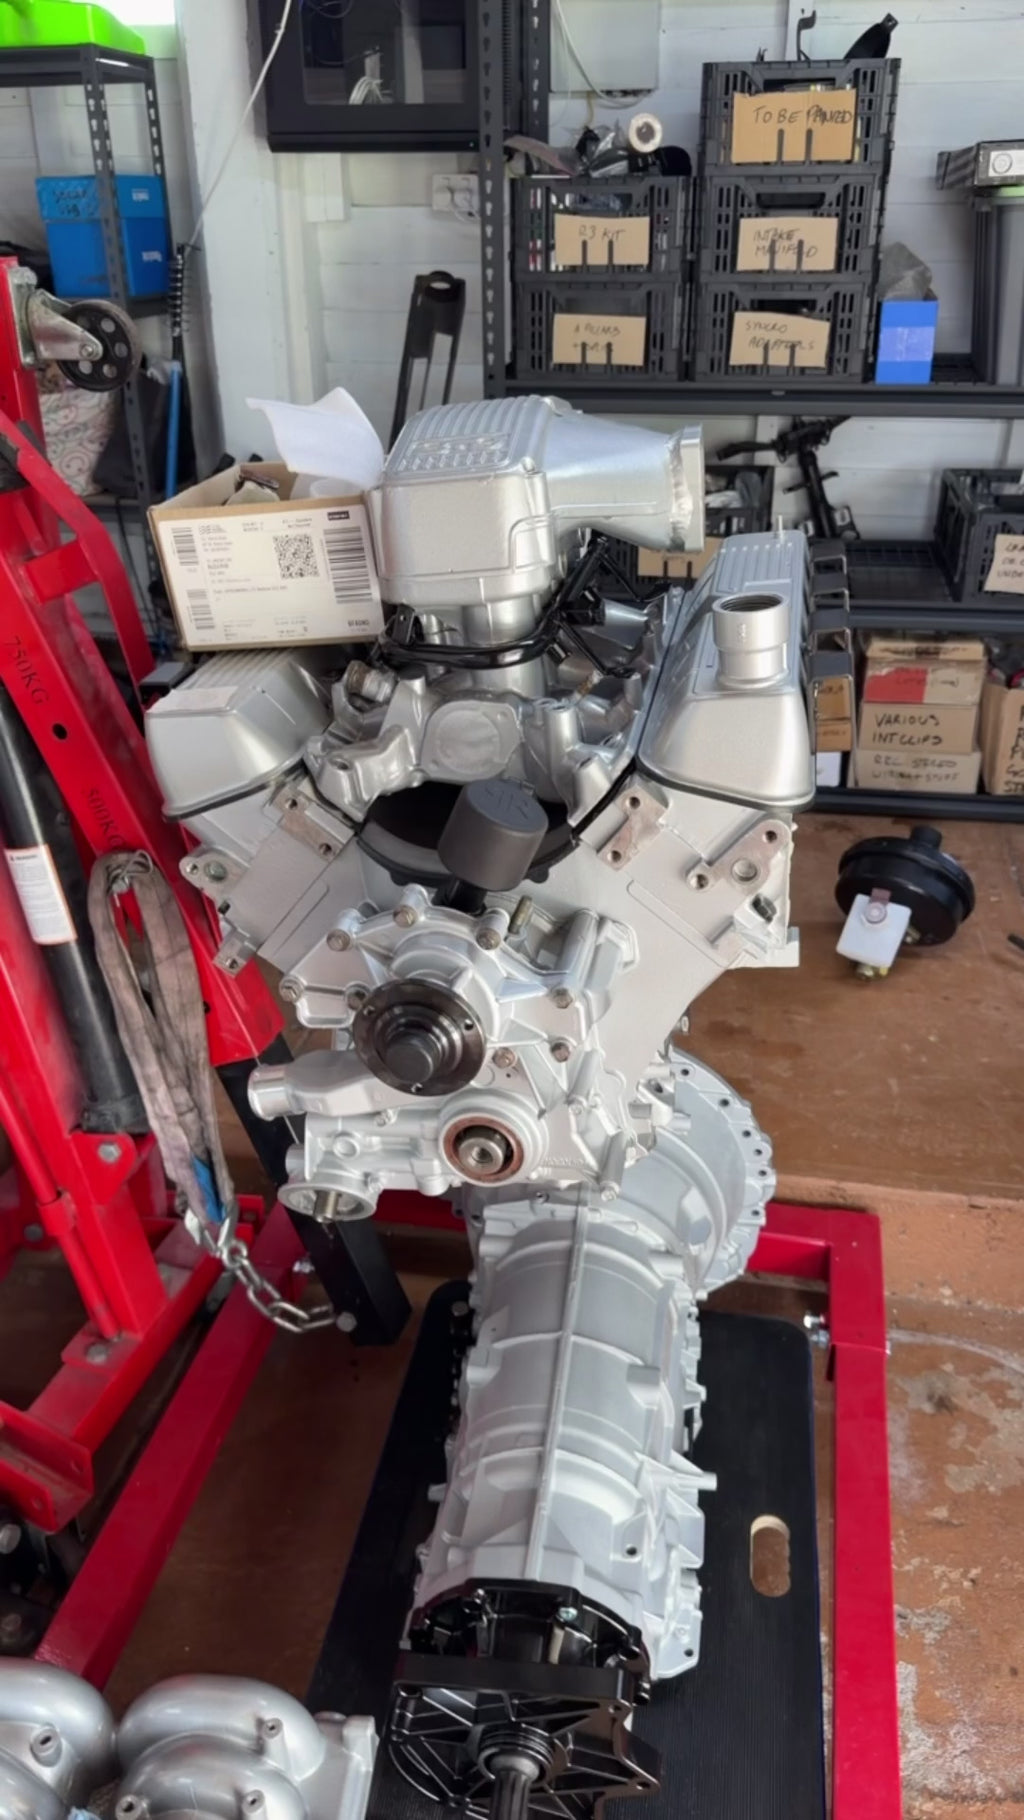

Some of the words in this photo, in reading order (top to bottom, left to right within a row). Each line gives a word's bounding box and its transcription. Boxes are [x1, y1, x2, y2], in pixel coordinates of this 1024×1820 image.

[753, 105, 773, 124] TO
[777, 108, 802, 124] BE
[3, 635, 50, 706] 750KG
[874, 714, 940, 728] VARIOUS
